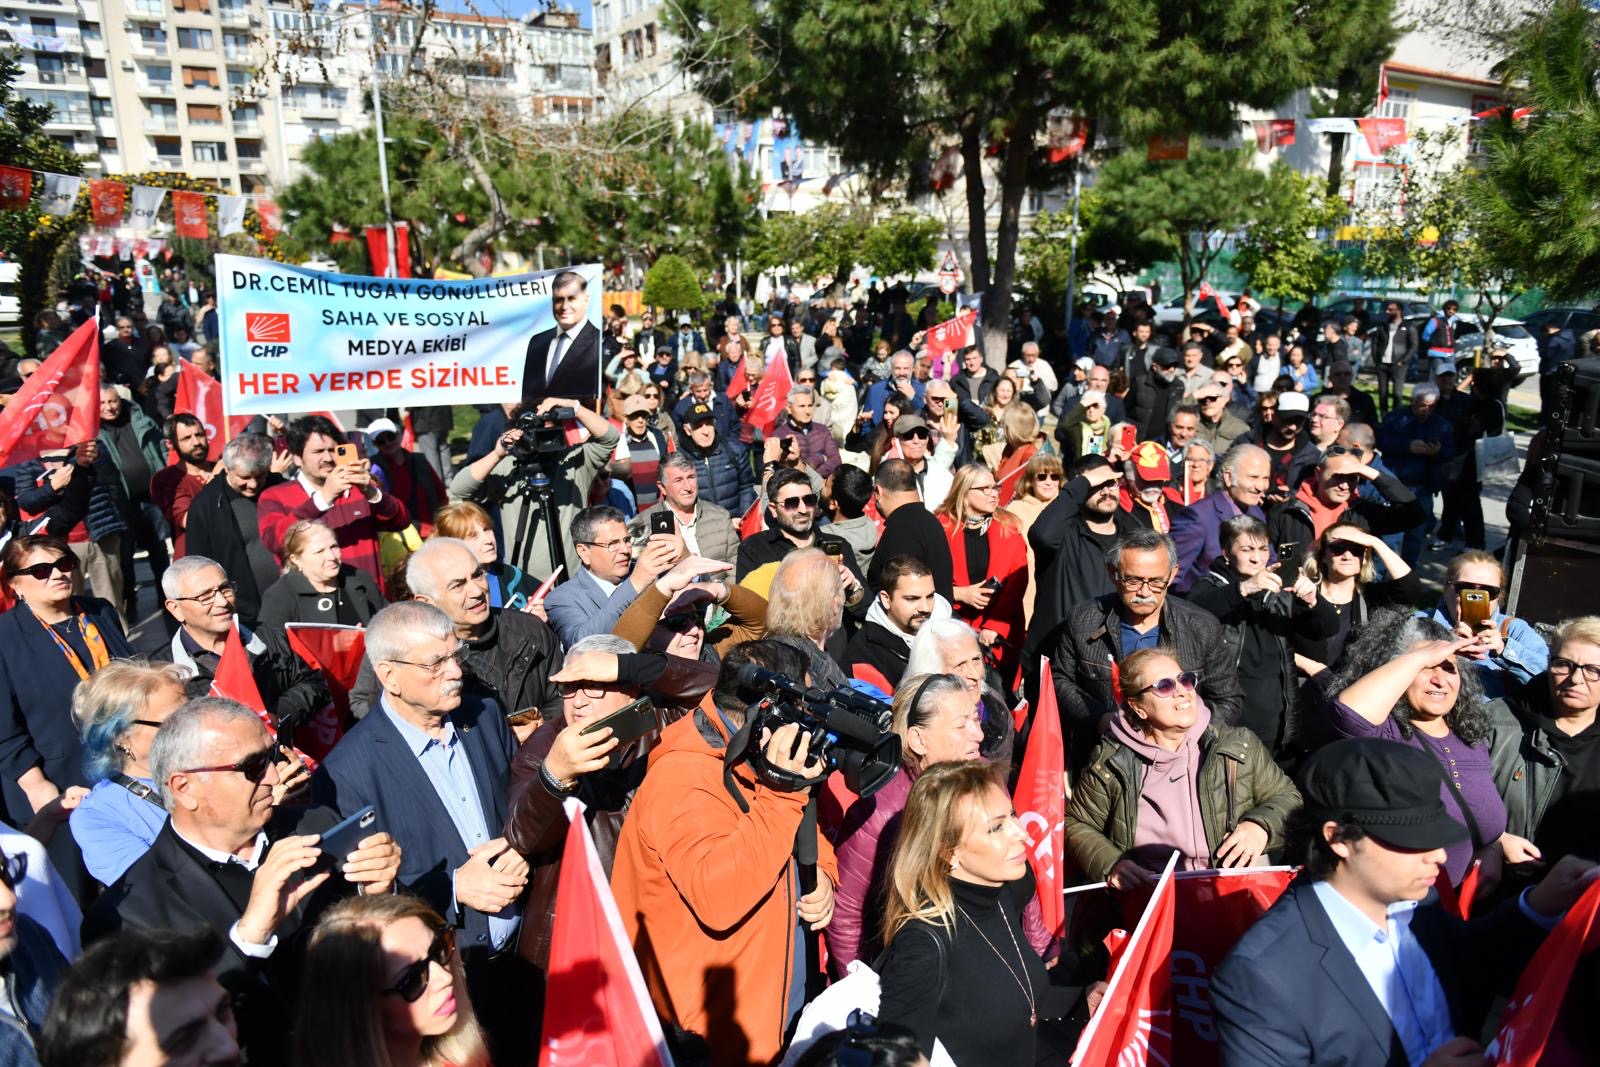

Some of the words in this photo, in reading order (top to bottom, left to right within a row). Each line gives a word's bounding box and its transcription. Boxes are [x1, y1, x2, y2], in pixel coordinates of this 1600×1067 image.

[135, 208, 155, 218] CHP
[232, 270, 336, 297] DR.CEMİL
[342, 280, 411, 300] TUGAY
[416, 275, 548, 300] GÖNÜLLÜLERİ
[322, 309, 378, 327] SAHA
[382, 312, 409, 327] VE
[415, 309, 490, 327] SOSYAL
[250, 344, 289, 358] CHP
[348, 339, 417, 356] MEDYA
[421, 334, 467, 353] EKİBİ
[238, 372, 300, 395] HER
[309, 369, 402, 392] YERDE
[411, 365, 517, 388] SİZİNLE.
[1170, 950, 1218, 1041] CHP
